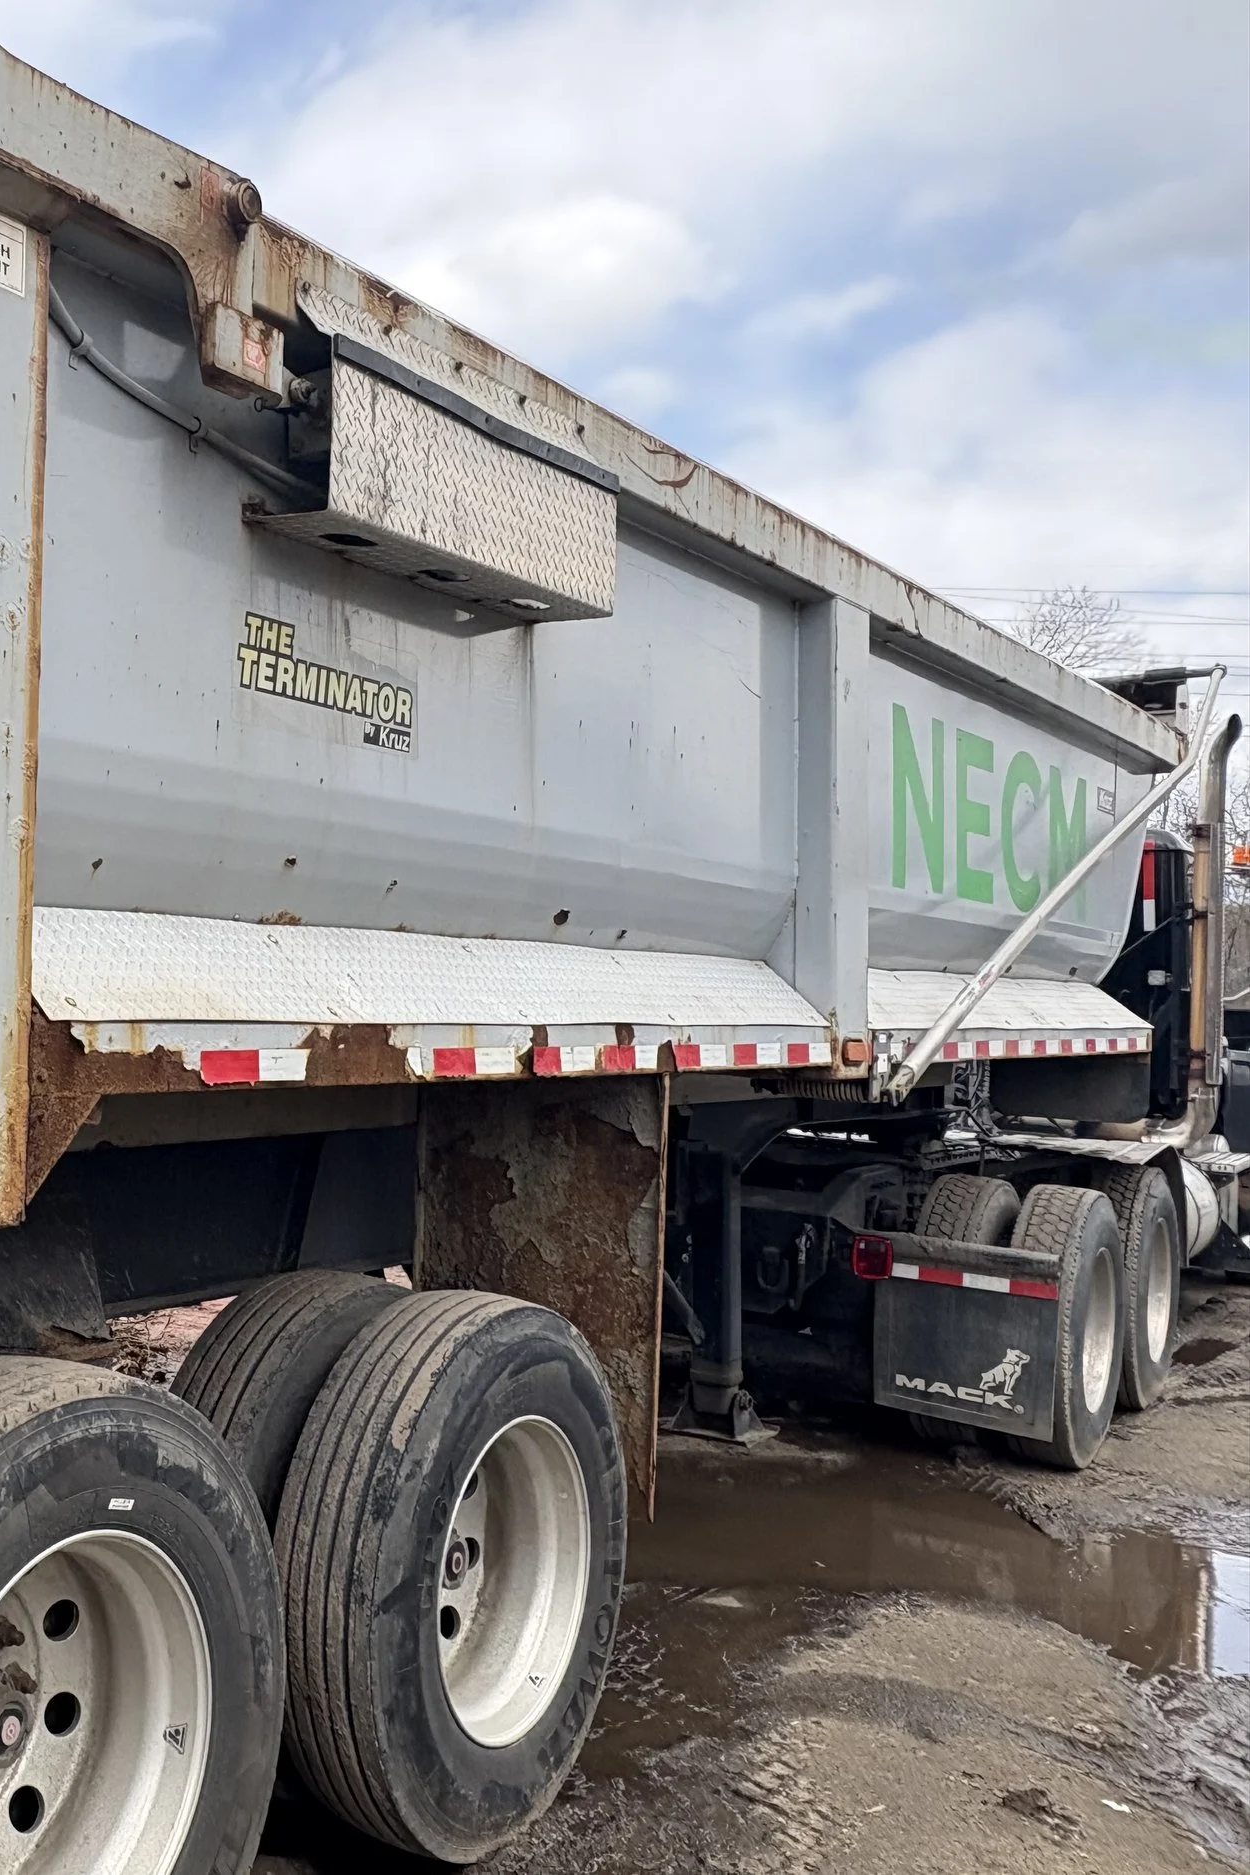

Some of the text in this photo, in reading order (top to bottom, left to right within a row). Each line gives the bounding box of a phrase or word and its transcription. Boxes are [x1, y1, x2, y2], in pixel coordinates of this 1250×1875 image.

[245, 612, 296, 656] THE
[238, 644, 413, 728] TERMINATOR
[379, 726, 410, 752] Kruz
[892, 702, 1088, 922] NECM
[895, 1373, 1013, 1410] MACK
